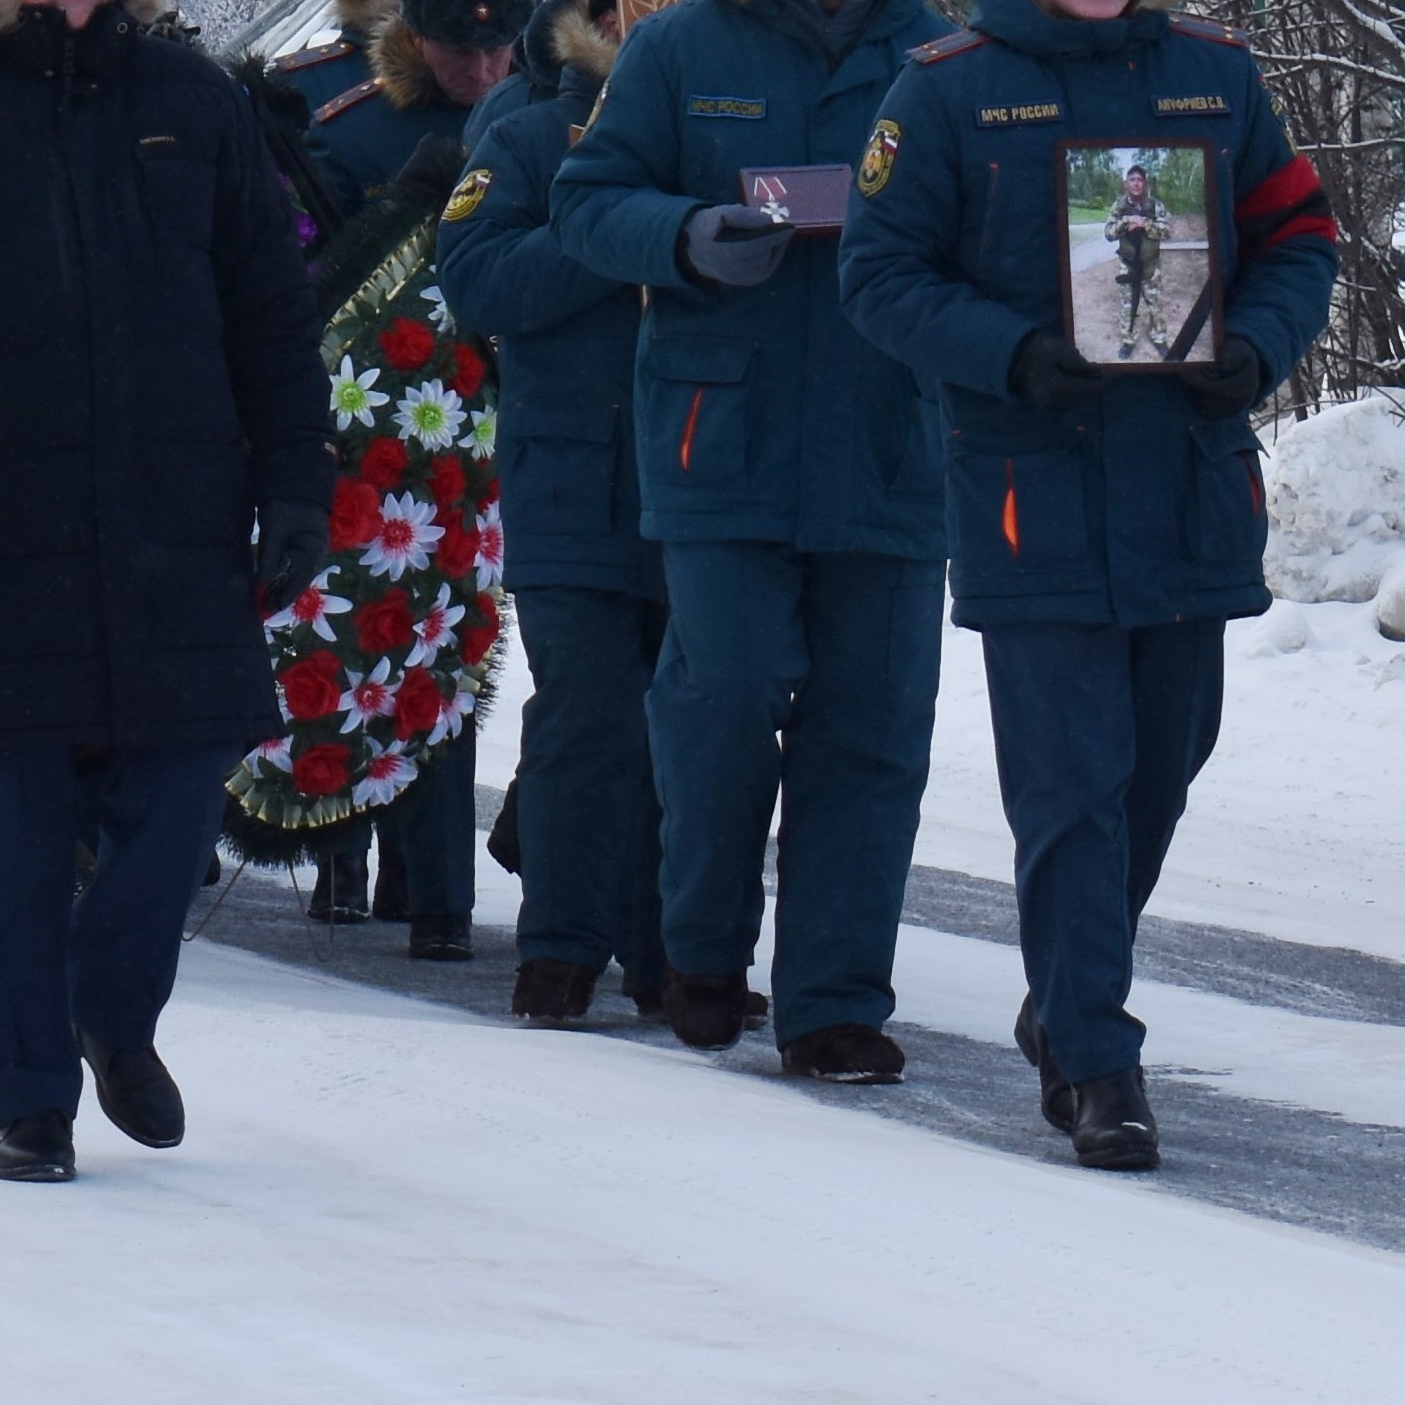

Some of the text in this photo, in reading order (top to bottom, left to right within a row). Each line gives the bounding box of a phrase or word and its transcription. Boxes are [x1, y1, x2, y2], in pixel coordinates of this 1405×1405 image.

[718, 100, 763, 115] РОССИИ
[981, 103, 1059, 122] МЧС РОССИИ
